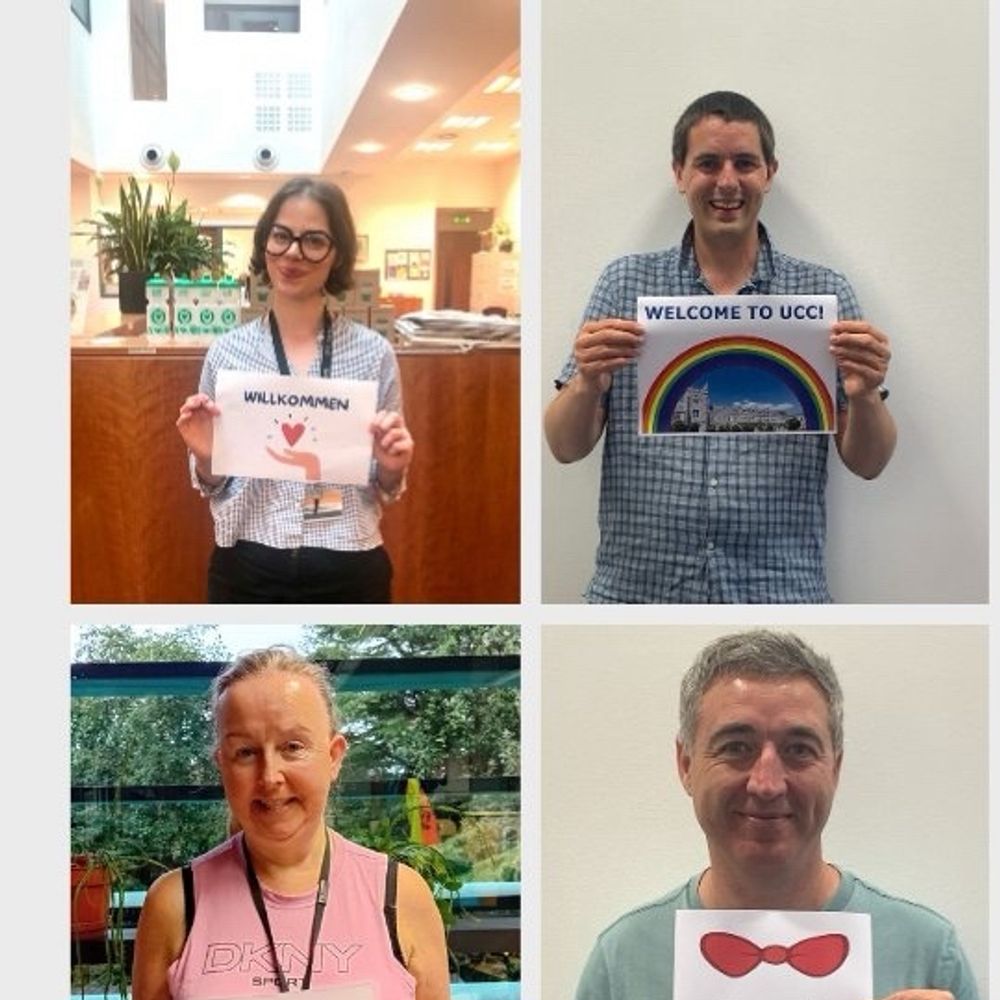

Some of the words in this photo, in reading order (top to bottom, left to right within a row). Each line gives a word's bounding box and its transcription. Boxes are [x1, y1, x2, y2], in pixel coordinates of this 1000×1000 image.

[644, 305, 741, 320] WELCOME
[748, 305, 773, 320] TO
[779, 305, 824, 320] UCC!
[243, 390, 350, 412] WILLKOMMEN
[203, 942, 363, 974] DKNY
